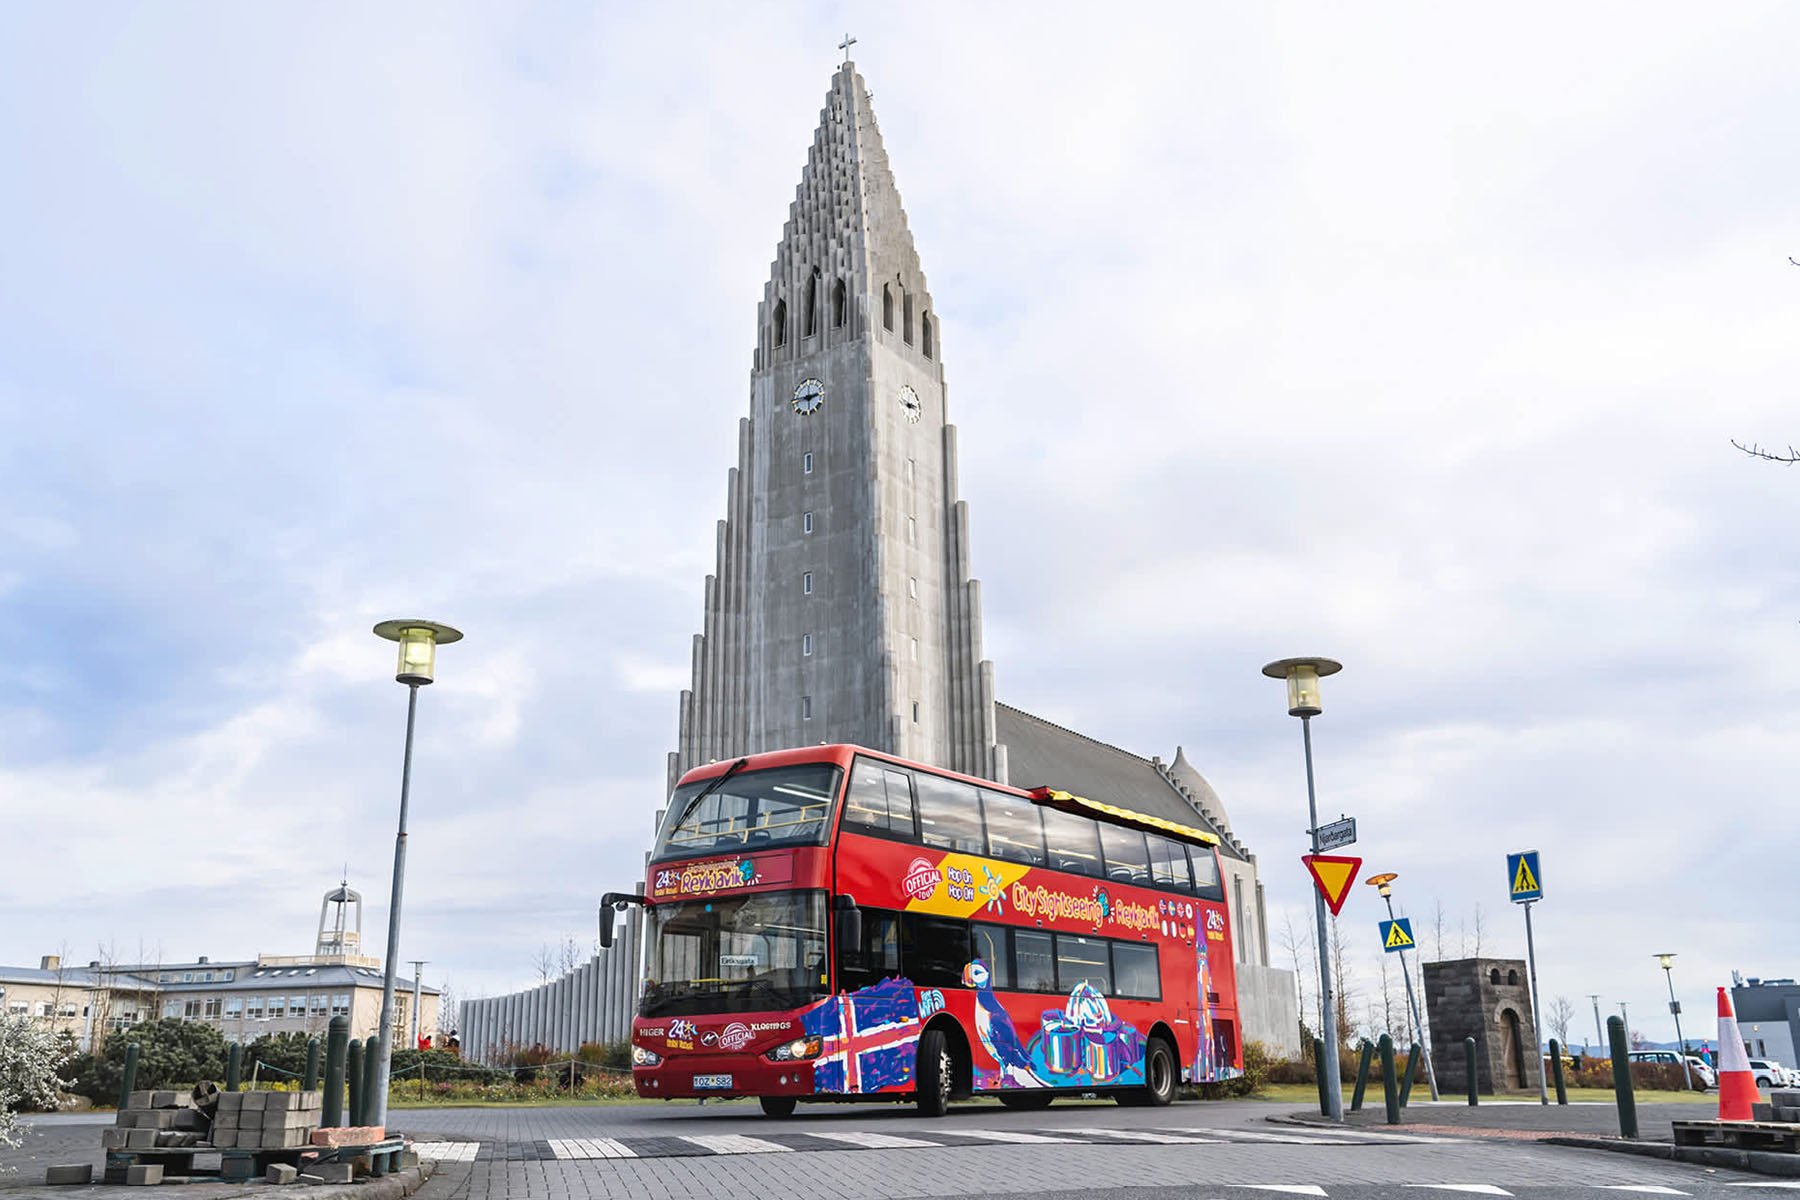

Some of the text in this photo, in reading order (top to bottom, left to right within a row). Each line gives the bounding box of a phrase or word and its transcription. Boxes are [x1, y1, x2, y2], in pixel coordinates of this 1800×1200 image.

[906, 869, 942, 893] OFFICIAL
[947, 866, 962, 883] Hop
[962, 869, 973, 885] On
[918, 887, 935, 900] TOUR
[948, 884, 975, 902] Hop Off
[639, 1028, 664, 1036] HIGER
[721, 1031, 754, 1046] OFFICIAL
